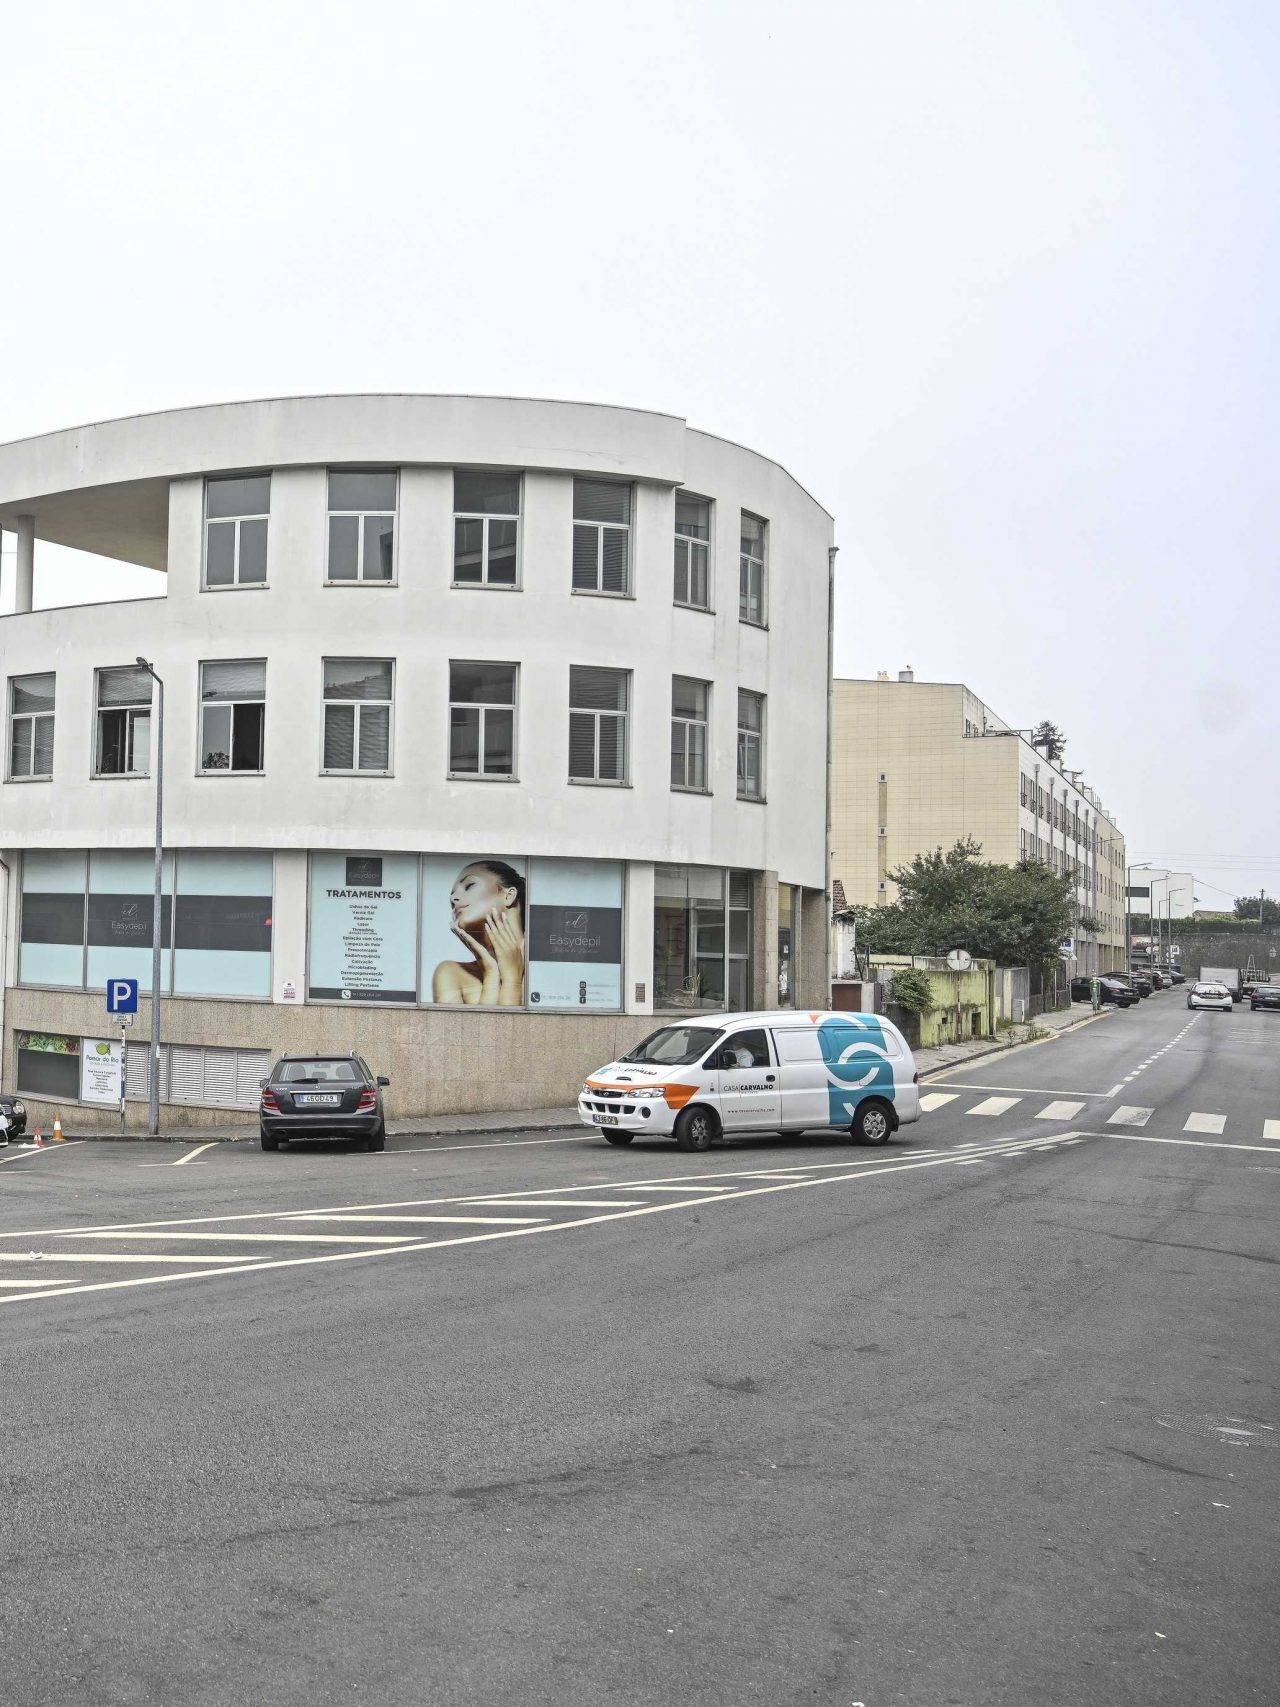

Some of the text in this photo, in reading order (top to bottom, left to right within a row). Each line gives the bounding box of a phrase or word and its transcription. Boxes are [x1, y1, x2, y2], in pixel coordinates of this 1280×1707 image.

[326, 889, 401, 899] TRATAMENTOS
[549, 934, 601, 947] Easydepil
[113, 982, 131, 1010] P
